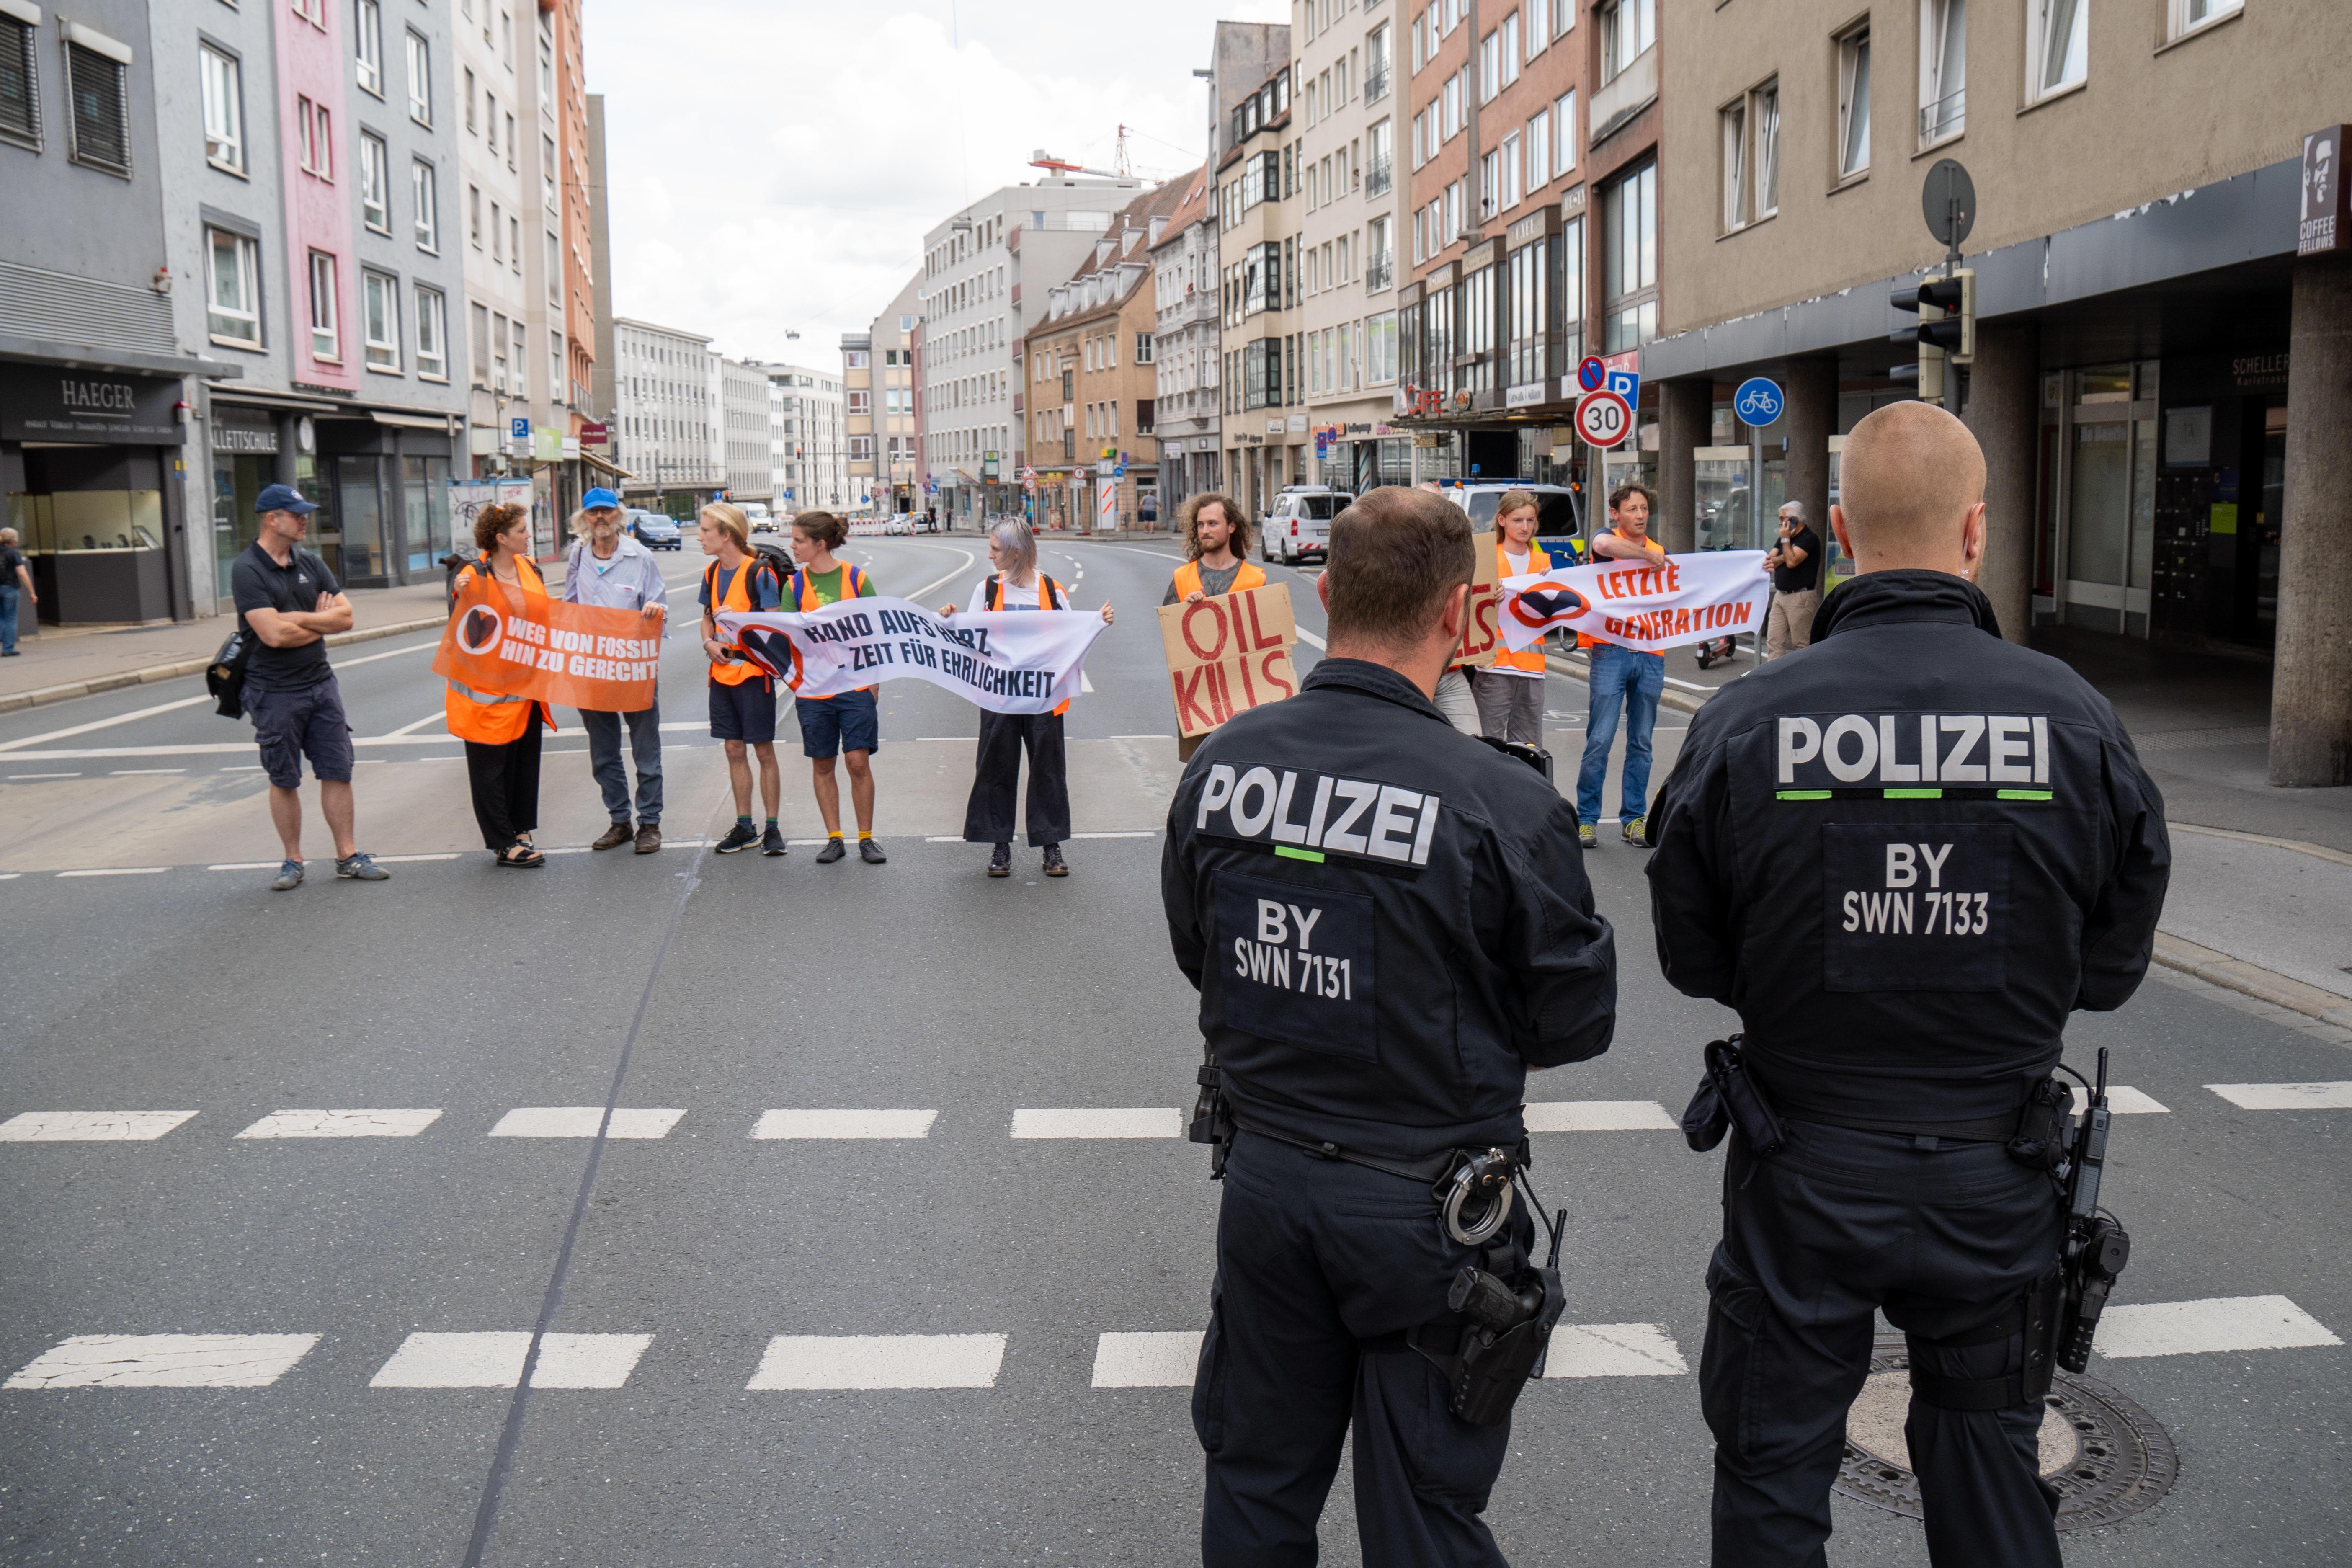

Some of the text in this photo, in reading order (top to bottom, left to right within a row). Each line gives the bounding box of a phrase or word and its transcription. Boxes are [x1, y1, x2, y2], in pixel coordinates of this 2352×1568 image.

[2298, 234, 2333, 254] FELLOWS
[2300, 214, 2334, 240] COFFEE
[61, 380, 136, 409] HAEGER
[1615, 376, 1631, 395] P
[514, 420, 524, 435] P
[1588, 406, 1619, 431] 30
[1597, 565, 1680, 600] LETZTE
[507, 616, 658, 659] WEG VON FOSSIL
[803, 613, 874, 644] HAND
[878, 609, 937, 638] AUFS
[1182, 590, 1283, 660] OIL
[1604, 602, 1752, 641] GENERATION
[500, 638, 658, 681] HIN ZU GERECHT
[848, 642, 894, 671] ZEIT
[899, 637, 937, 669] FÜR
[941, 648, 1055, 699] EHRLICHKEIT
[1173, 650, 1293, 732] KILLS
[1778, 714, 2049, 784] POLIZEI
[1196, 764, 1440, 866] POLIZEI
[1886, 843, 1954, 888] BY
[1257, 898, 1322, 950] BY
[1842, 890, 1989, 935] SWN 7133
[1235, 937, 1351, 1001] SWN 7131
